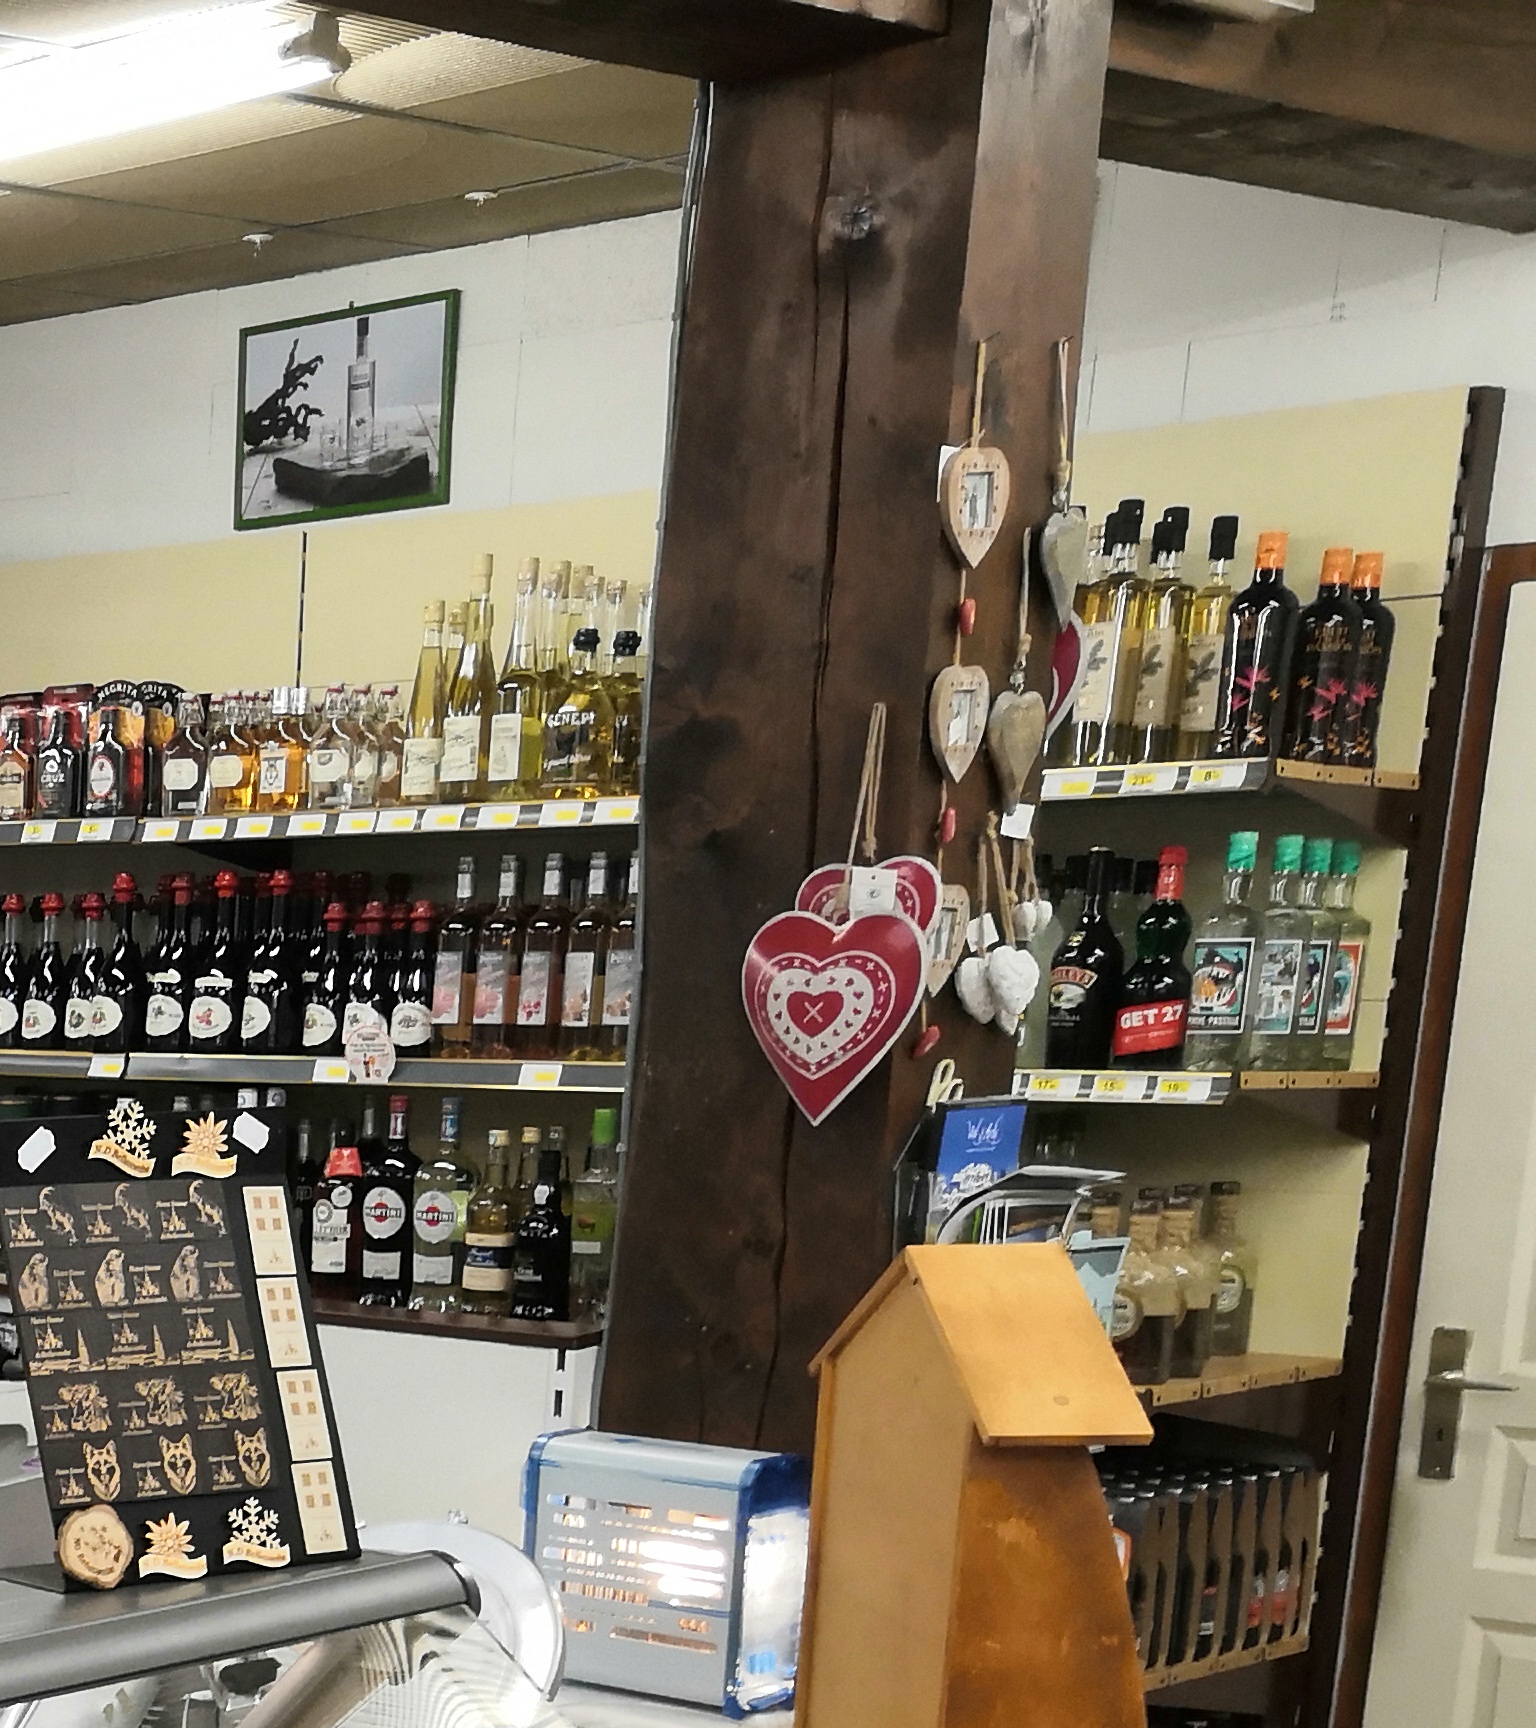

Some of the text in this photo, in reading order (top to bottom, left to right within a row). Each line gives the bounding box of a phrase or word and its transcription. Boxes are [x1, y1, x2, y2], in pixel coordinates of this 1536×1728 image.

[1120, 1008, 1158, 1029] GET
[1161, 1003, 1185, 1022] 27
[415, 1210, 456, 1224] MARTINI
